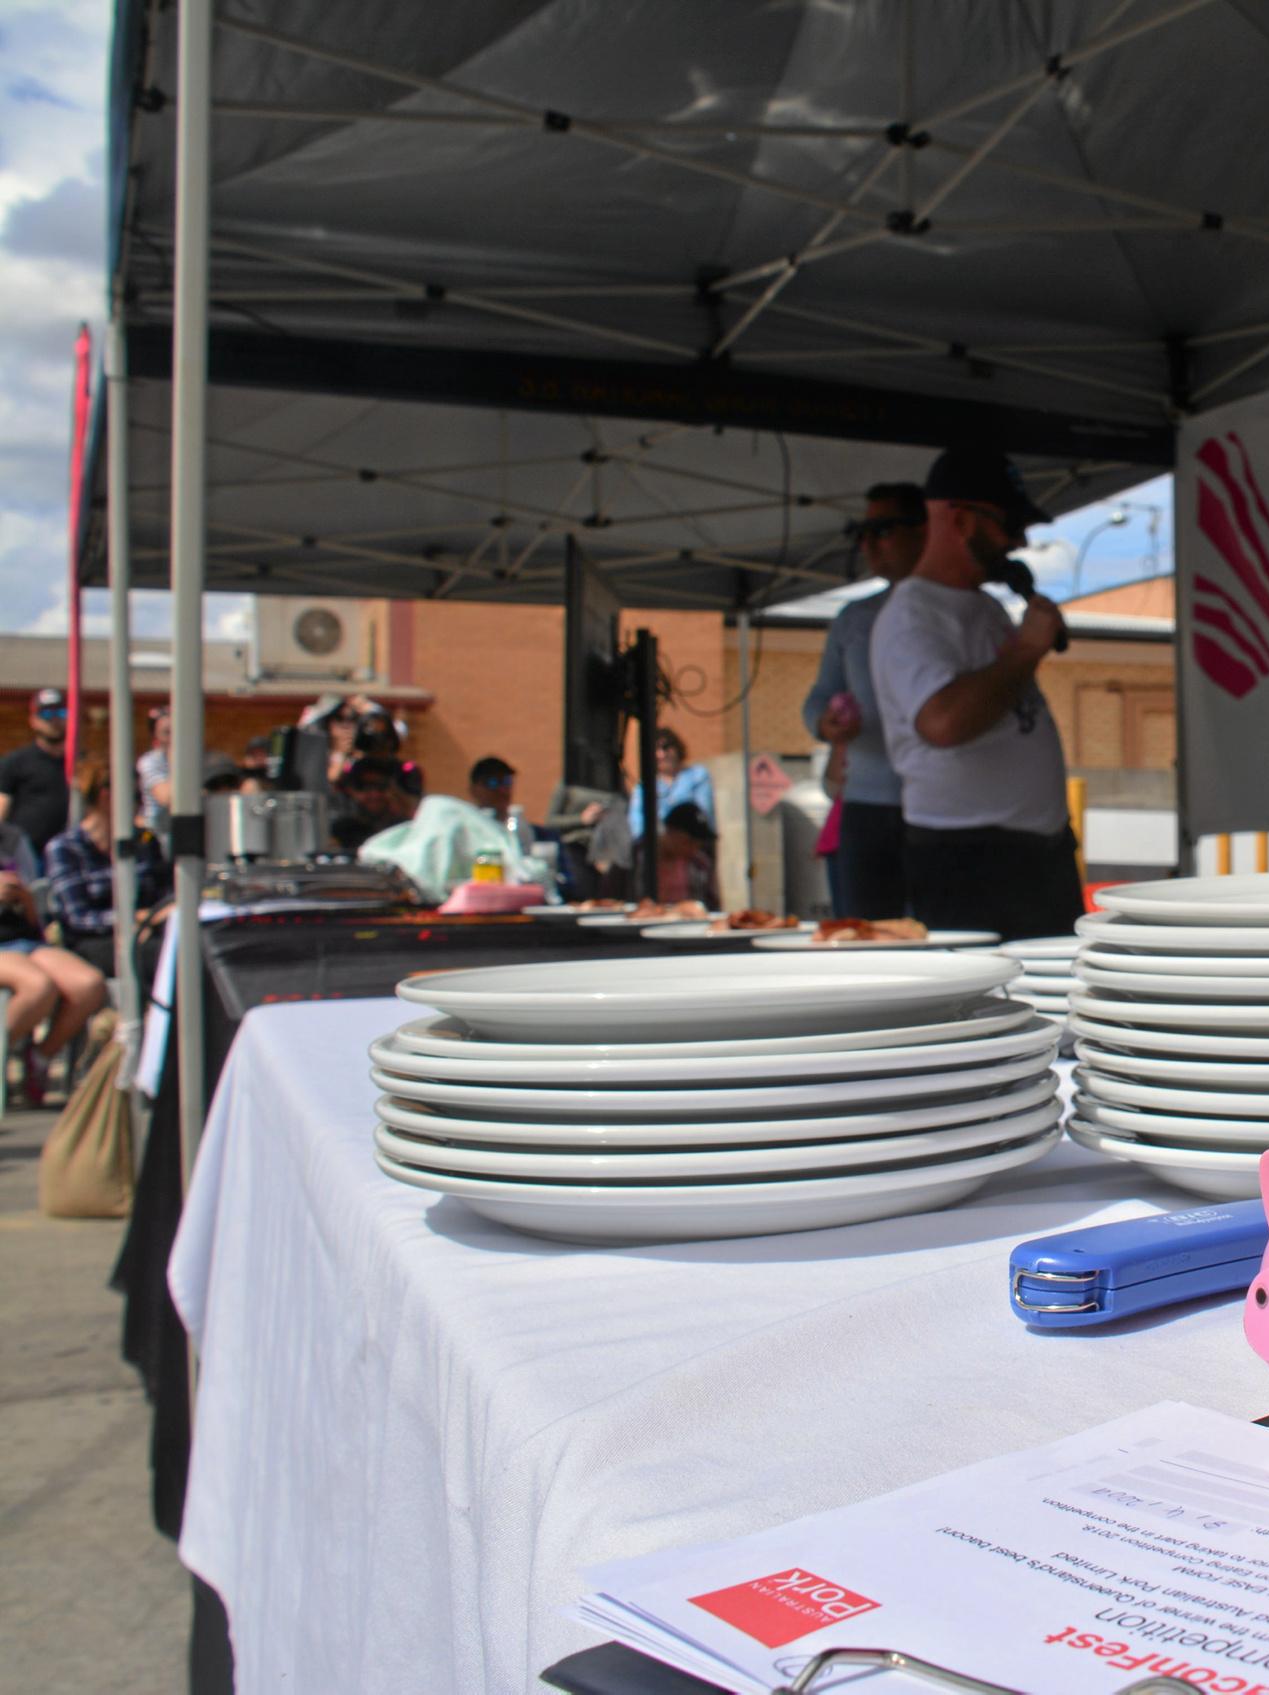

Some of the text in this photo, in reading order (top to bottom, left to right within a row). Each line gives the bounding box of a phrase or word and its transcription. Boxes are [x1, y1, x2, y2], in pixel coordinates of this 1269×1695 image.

[935, 1525, 992, 1552] bacon!
[1115, 1521, 1141, 1536] the
[1152, 1533, 1186, 1547] part
[988, 1545, 1028, 1565] best
[1118, 1535, 1205, 1566] Competition
[1184, 1541, 1229, 1560] taking
[1229, 1553, 1246, 1564] to
[1049, 1550, 1119, 1582] Limited
[1171, 1564, 1223, 1584] FORM
[1205, 1559, 1254, 1579] Eating
[1025, 1558, 1136, 1606] Queensland's
[1119, 1574, 1160, 1593] Pork
[749, 1582, 834, 1624] AUSTRALIAN
[772, 1570, 873, 1619] Pork
[1160, 1584, 1253, 1620] Australian
[1134, 1598, 1157, 1612] of
[1156, 1605, 1217, 1628] winner
[1217, 1621, 1250, 1638] the
